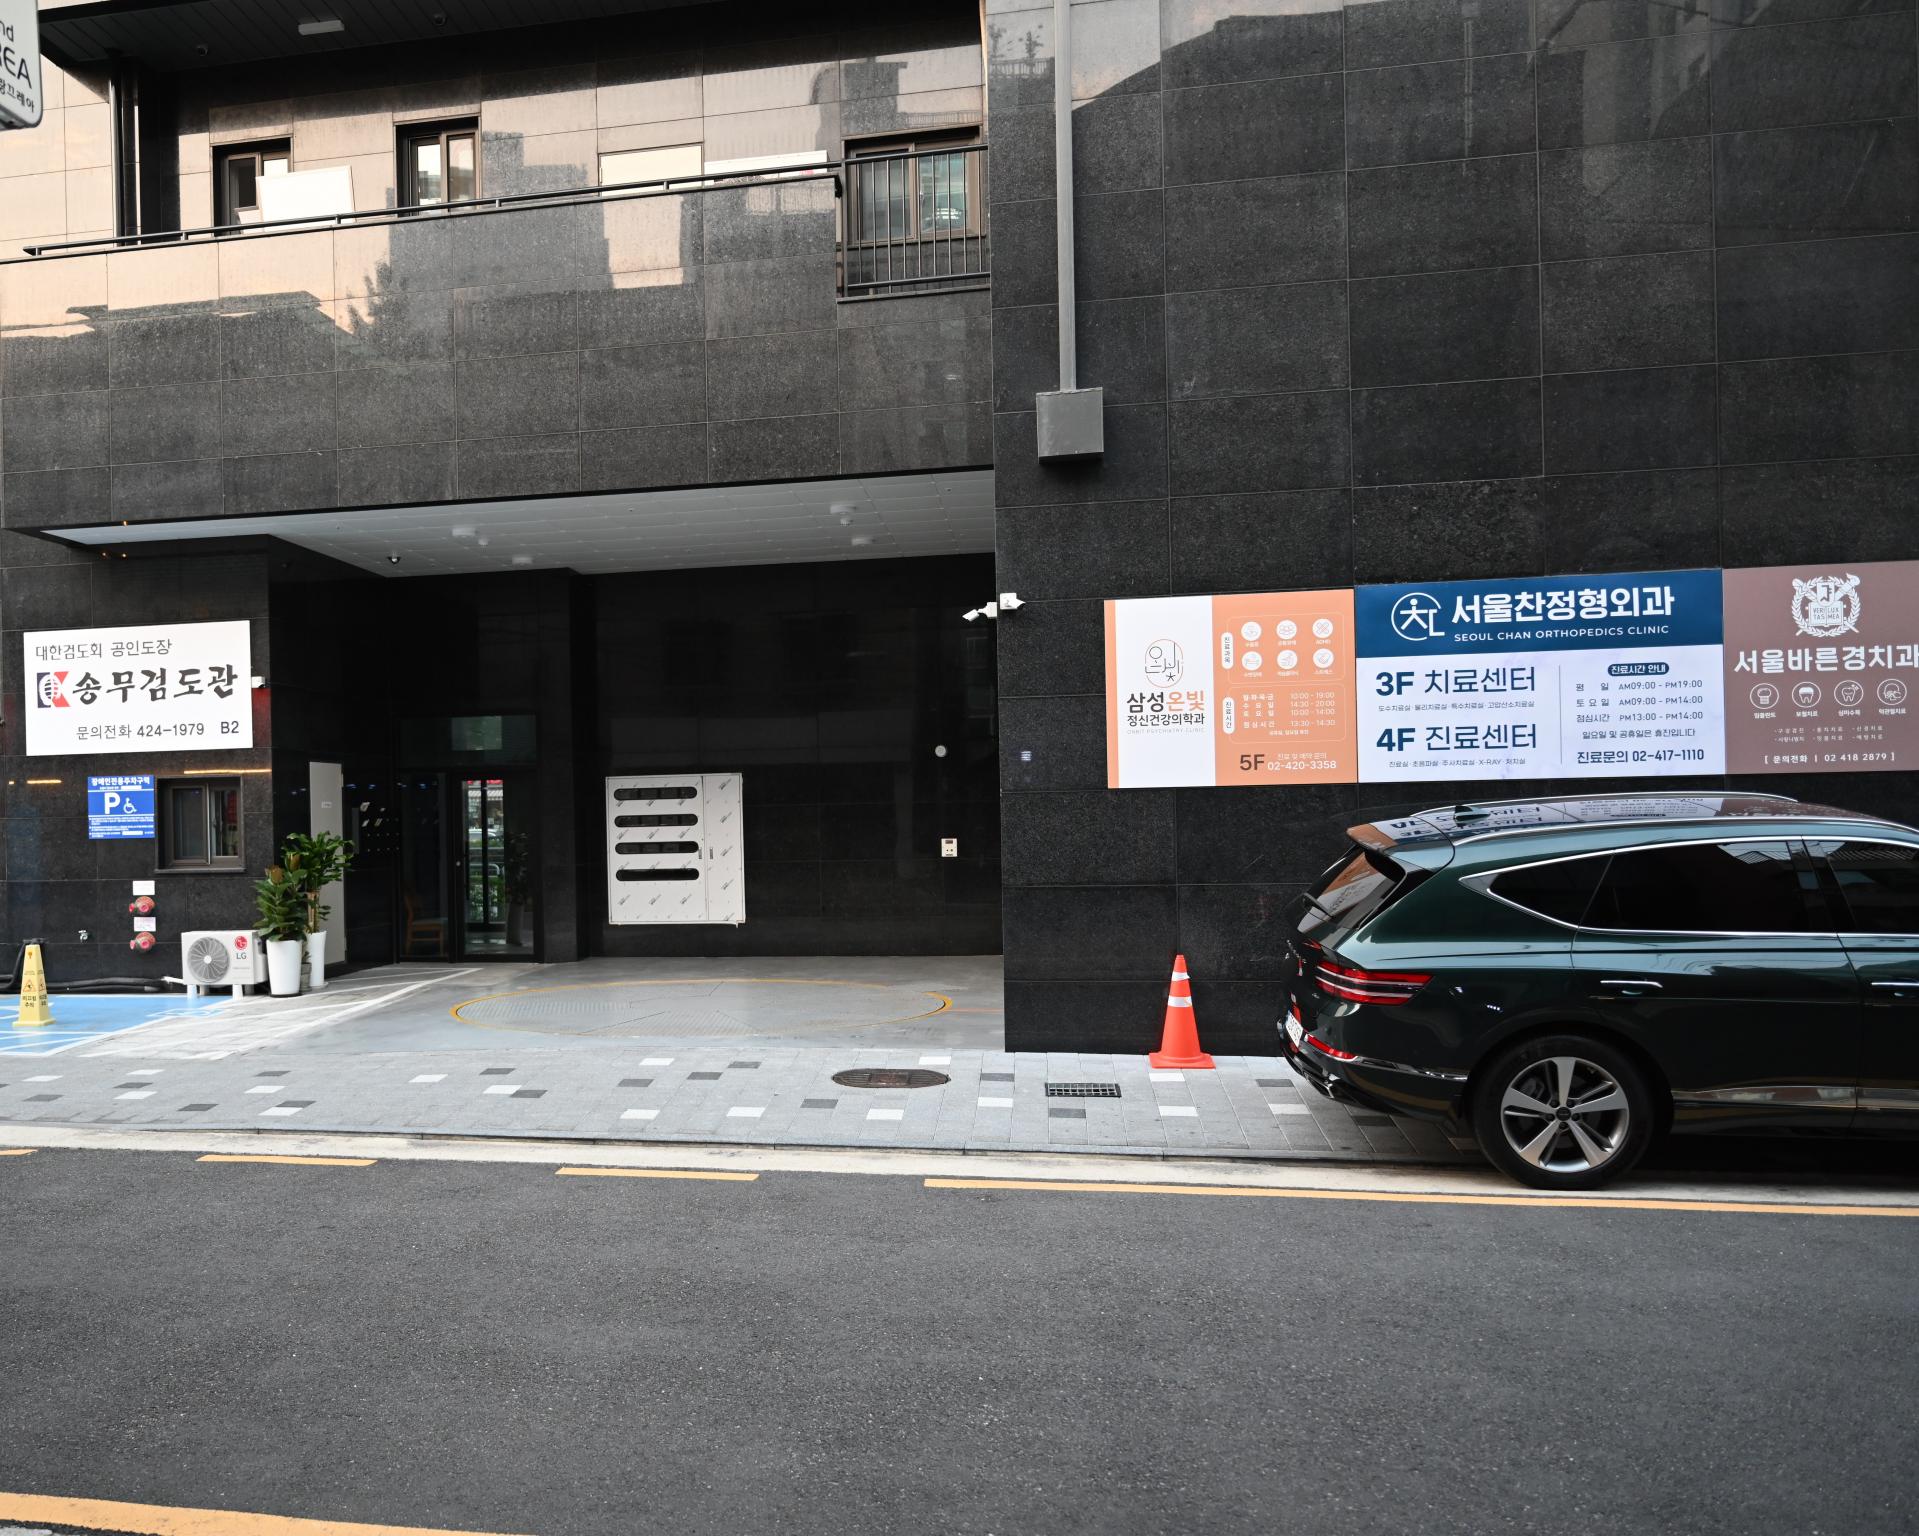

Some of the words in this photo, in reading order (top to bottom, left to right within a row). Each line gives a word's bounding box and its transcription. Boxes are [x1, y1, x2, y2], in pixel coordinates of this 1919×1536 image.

[0, 43, 32, 89] EA
[1451, 585, 1675, 625] 서울찬정형외과
[1454, 632, 1494, 643] SEOUL
[1497, 631, 1531, 641] CHAN
[1536, 626, 1624, 640] ORTHOPEDICS
[1628, 624, 1669, 635] CLINIC
[35, 642, 102, 660] 대한검도회
[111, 639, 172, 657] 공인도장
[1734, 644, 1919, 674] 서울바른경치과
[1611, 665, 1645, 675] 진료시간
[1648, 664, 1666, 673] 안내
[72, 664, 238, 705] 송무검도관
[1376, 672, 1414, 696] 3F
[1425, 667, 1535, 694] 치료센터
[1618, 682, 1656, 690] AM09:00
[1665, 680, 1702, 688] PM19:00
[1127, 690, 1204, 713] 삼성온빛
[1619, 697, 1656, 706] AM09:00
[1666, 696, 1703, 704] PM14:00
[1127, 713, 1205, 727] 정신건강의학과
[1577, 714, 1610, 723] 점심시간
[1620, 713, 1656, 721] PM13:00
[1666, 712, 1703, 720] PM14:00
[77, 724, 131, 740] 문의전화
[137, 723, 204, 737] 424-1979
[221, 721, 239, 734] B2
[1376, 728, 1415, 752] 4F
[1425, 724, 1537, 751] 진료센터
[1582, 731, 1607, 739] 일요일
[1609, 730, 1617, 739] 및
[1619, 729, 1652, 738] 공휴일은
[1655, 728, 1696, 737] 휴진입니다
[1240, 754, 1264, 771] 5F
[1267, 760, 1336, 771] 02-420-3358
[1577, 750, 1628, 764] 진료문의
[1632, 749, 1704, 762] 02-417-1110
[1773, 755, 1808, 763] 문의전화
[1824, 754, 1836, 762] 02
[1863, 753, 1887, 761] 2879
[104, 792, 120, 814] P
